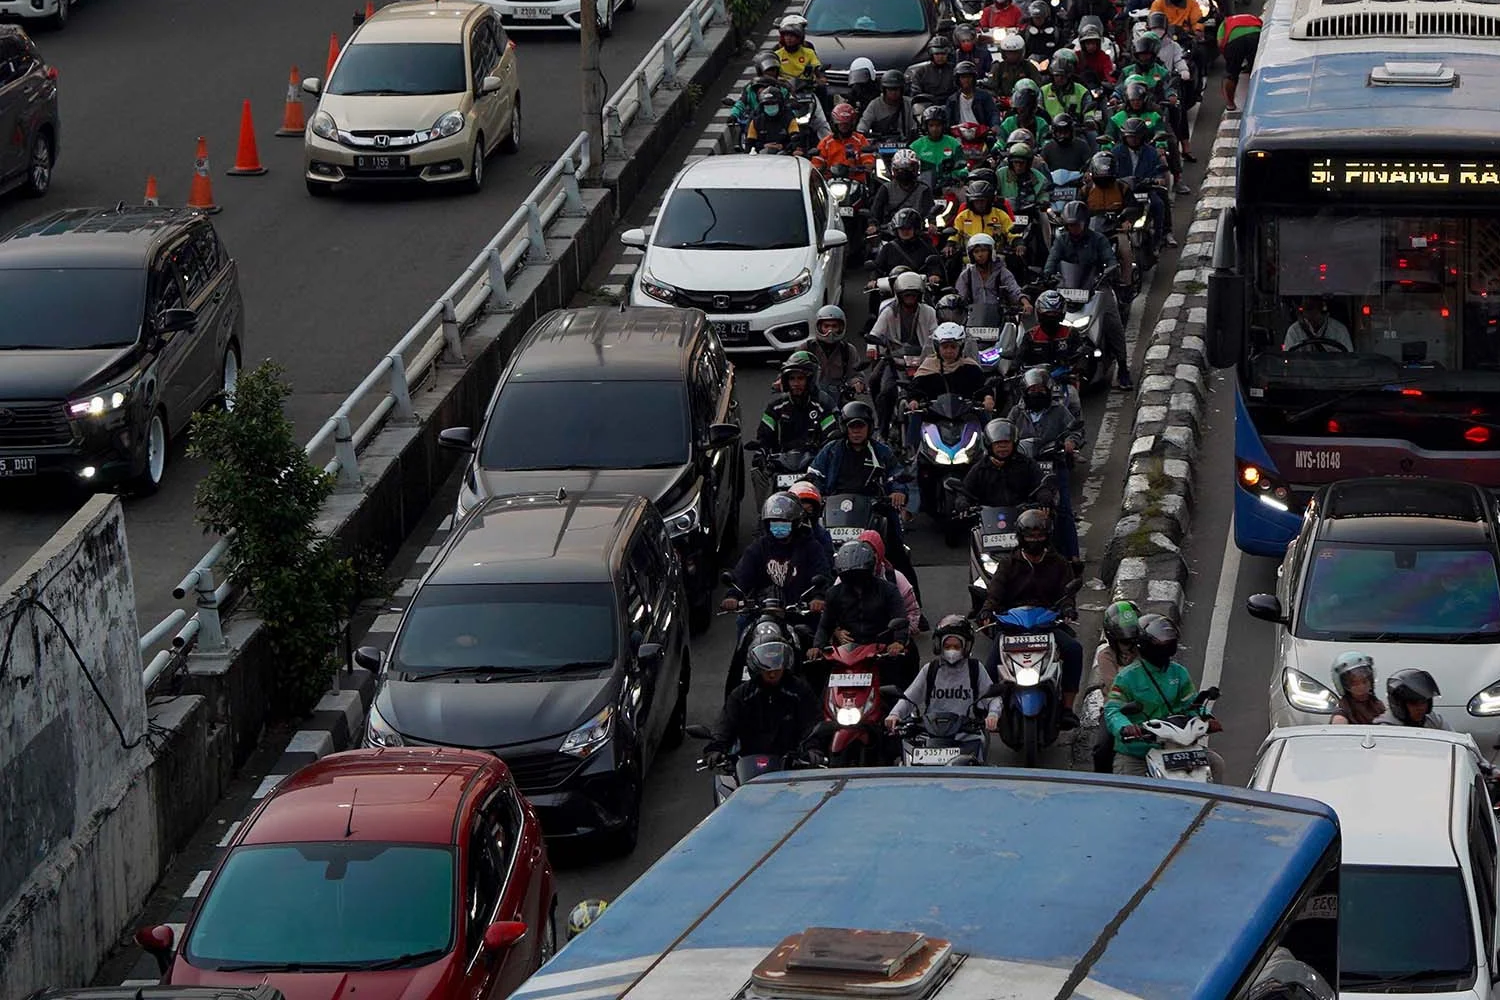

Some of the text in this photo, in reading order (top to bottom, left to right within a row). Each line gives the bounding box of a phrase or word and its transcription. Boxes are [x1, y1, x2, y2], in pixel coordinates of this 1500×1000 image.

[1345, 163, 1450, 184] PINANG
[14, 458, 34, 471] DUT
[1295, 450, 1342, 469] MYS-18148
[924, 748, 942, 756] 5357
